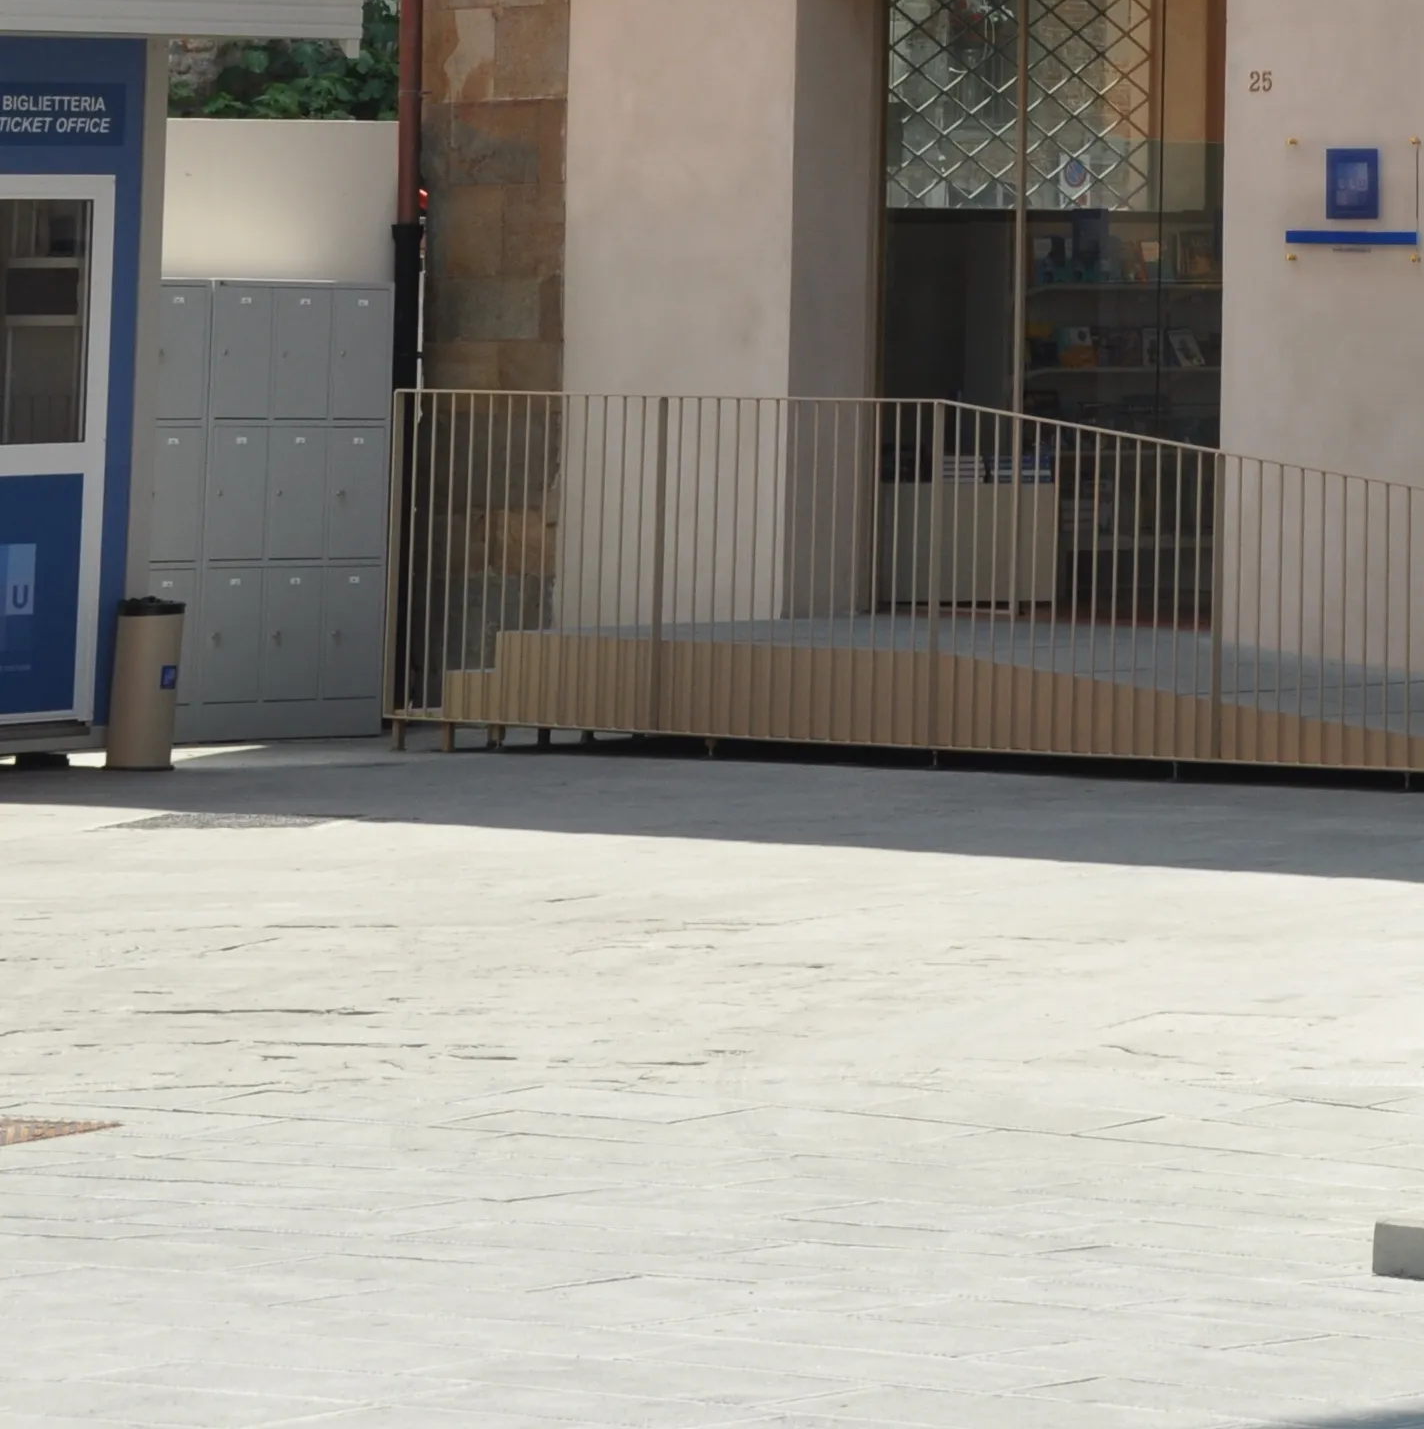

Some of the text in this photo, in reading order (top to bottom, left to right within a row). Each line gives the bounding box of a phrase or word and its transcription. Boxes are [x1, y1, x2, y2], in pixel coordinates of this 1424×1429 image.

[1249, 71, 1272, 92] 25
[2, 95, 106, 111] BIGLIETTERIA
[56, 117, 111, 133] OFFICE
